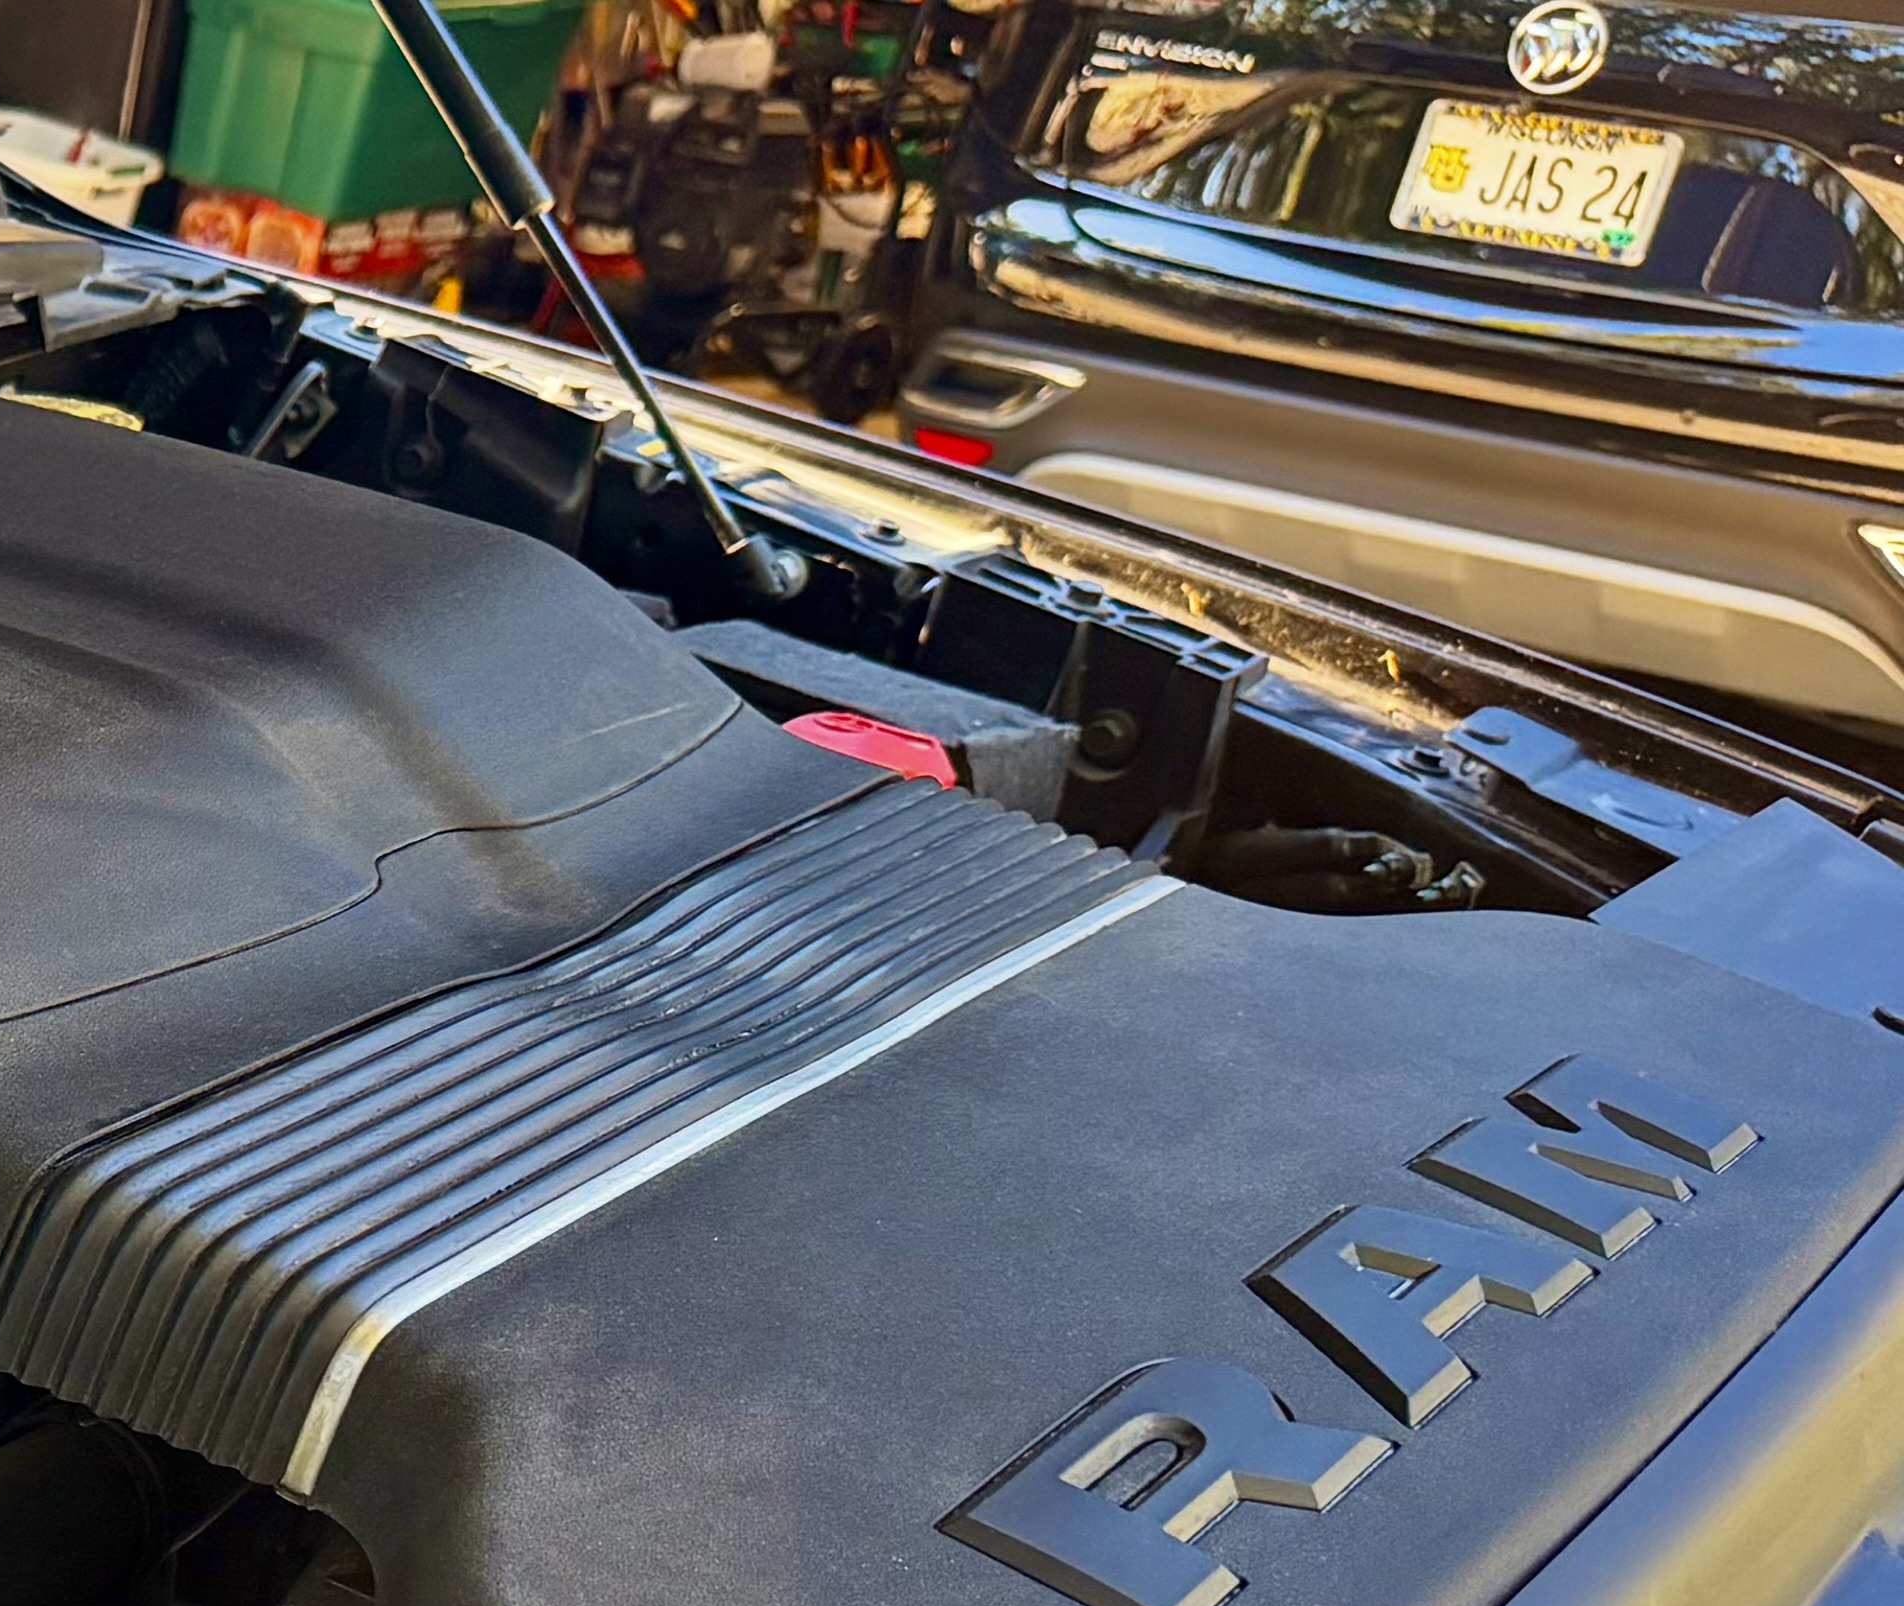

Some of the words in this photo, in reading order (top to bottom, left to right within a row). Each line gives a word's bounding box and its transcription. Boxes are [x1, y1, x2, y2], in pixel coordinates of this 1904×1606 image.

[1096, 28, 1256, 73] ENVISION
[1479, 150, 1574, 214] JAS
[1580, 165, 1648, 229] 24
